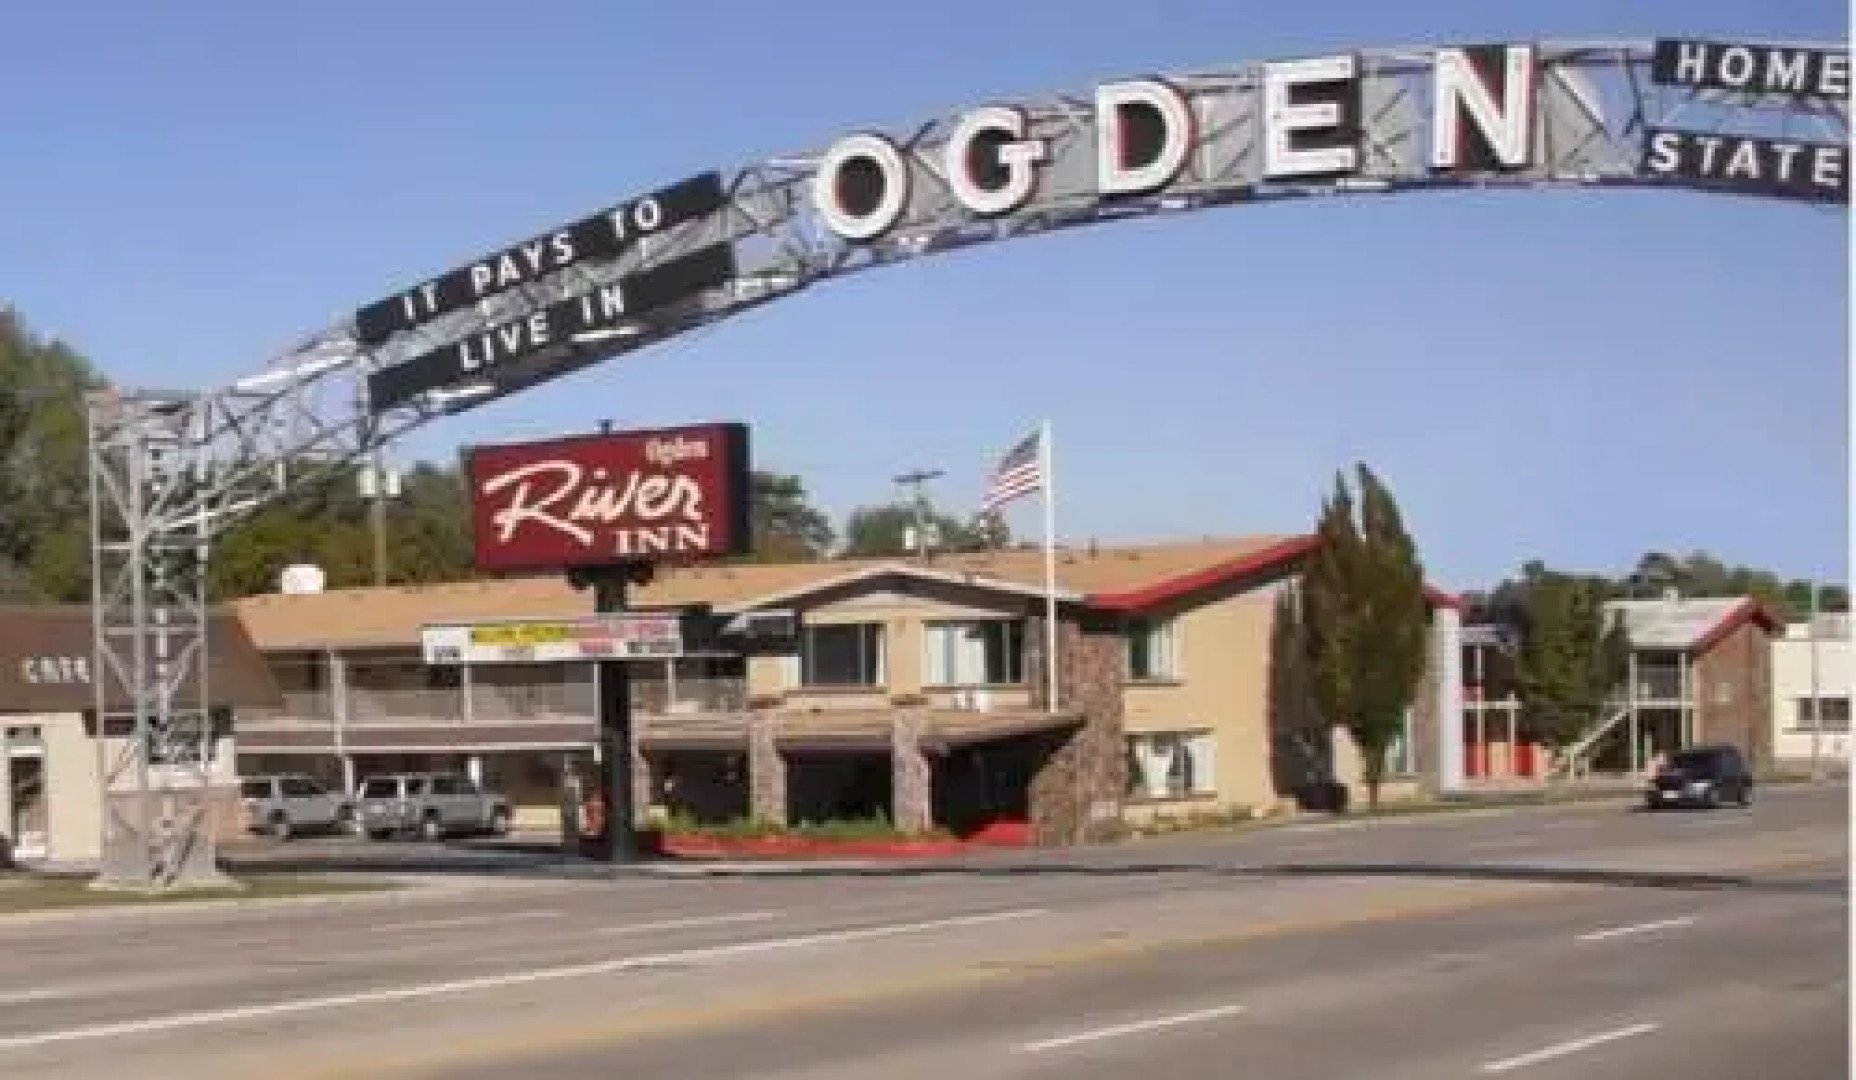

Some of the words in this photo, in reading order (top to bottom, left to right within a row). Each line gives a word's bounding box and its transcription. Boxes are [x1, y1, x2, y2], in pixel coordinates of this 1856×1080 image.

[1676, 44, 1848, 93] HOME
[816, 44, 1534, 240] OGDEN
[1648, 132, 1842, 186] STATE
[402, 283, 439, 320] IT
[470, 232, 575, 294] PAYS
[613, 199, 661, 239] TO
[459, 311, 549, 371] LIVE
[581, 285, 625, 323] IN
[645, 436, 709, 464] Ogden
[482, 459, 702, 547] River
[614, 522, 710, 555] INN
